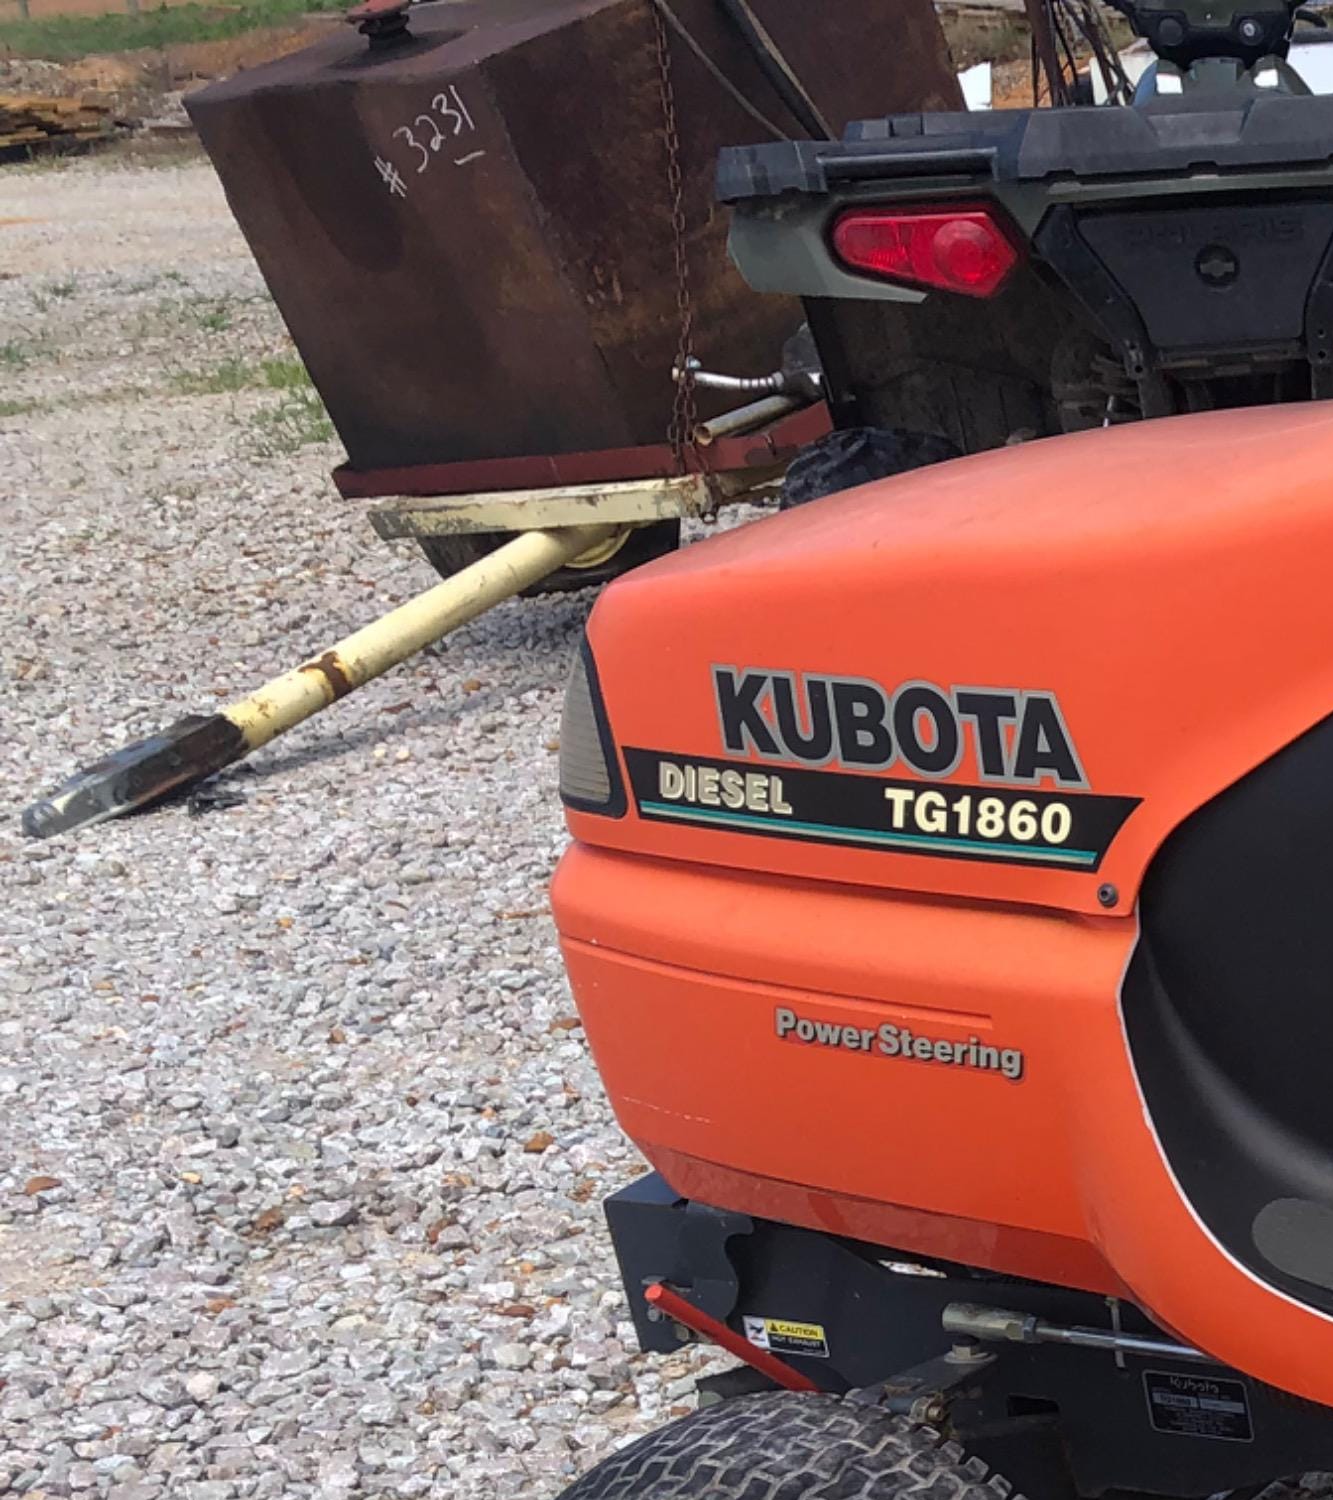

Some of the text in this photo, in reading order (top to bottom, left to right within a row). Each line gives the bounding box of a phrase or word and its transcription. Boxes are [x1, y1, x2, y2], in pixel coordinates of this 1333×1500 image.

[710, 663, 1091, 790] KUBOTA
[657, 761, 793, 815] DIESEL
[884, 786, 1073, 845] TG1860
[779, 1325, 819, 1337] CAUTION
[1170, 1376, 1219, 1393] Kubota
